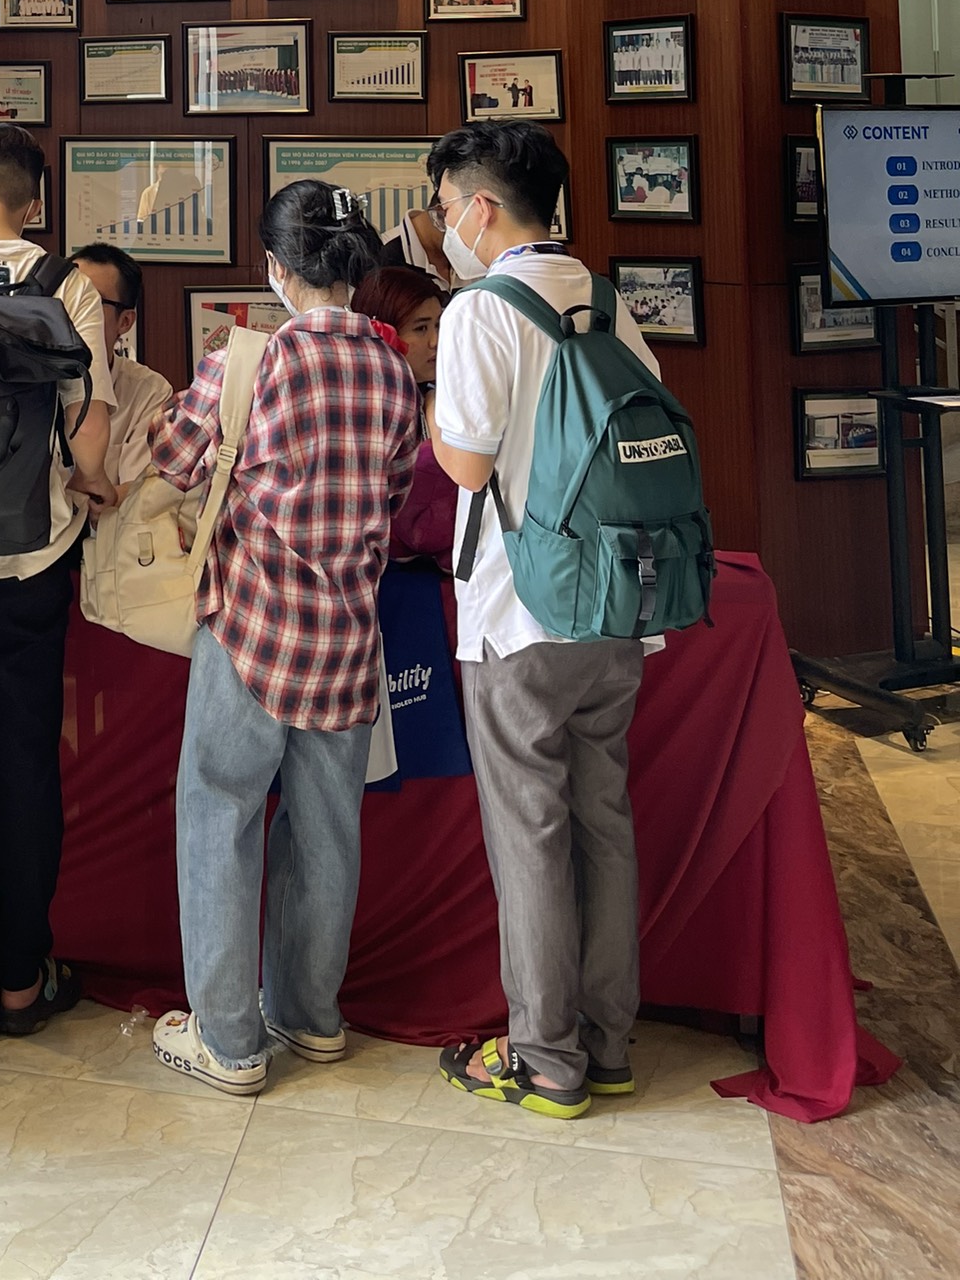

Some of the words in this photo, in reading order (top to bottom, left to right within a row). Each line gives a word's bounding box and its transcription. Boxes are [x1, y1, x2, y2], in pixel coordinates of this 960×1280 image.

[862, 126, 930, 140] CONTENT
[896, 162, 906, 171] 01
[898, 190, 908, 199] 02
[899, 219, 910, 228] 03
[901, 247, 911, 256] 04
[152, 1041, 192, 1072] crocs
